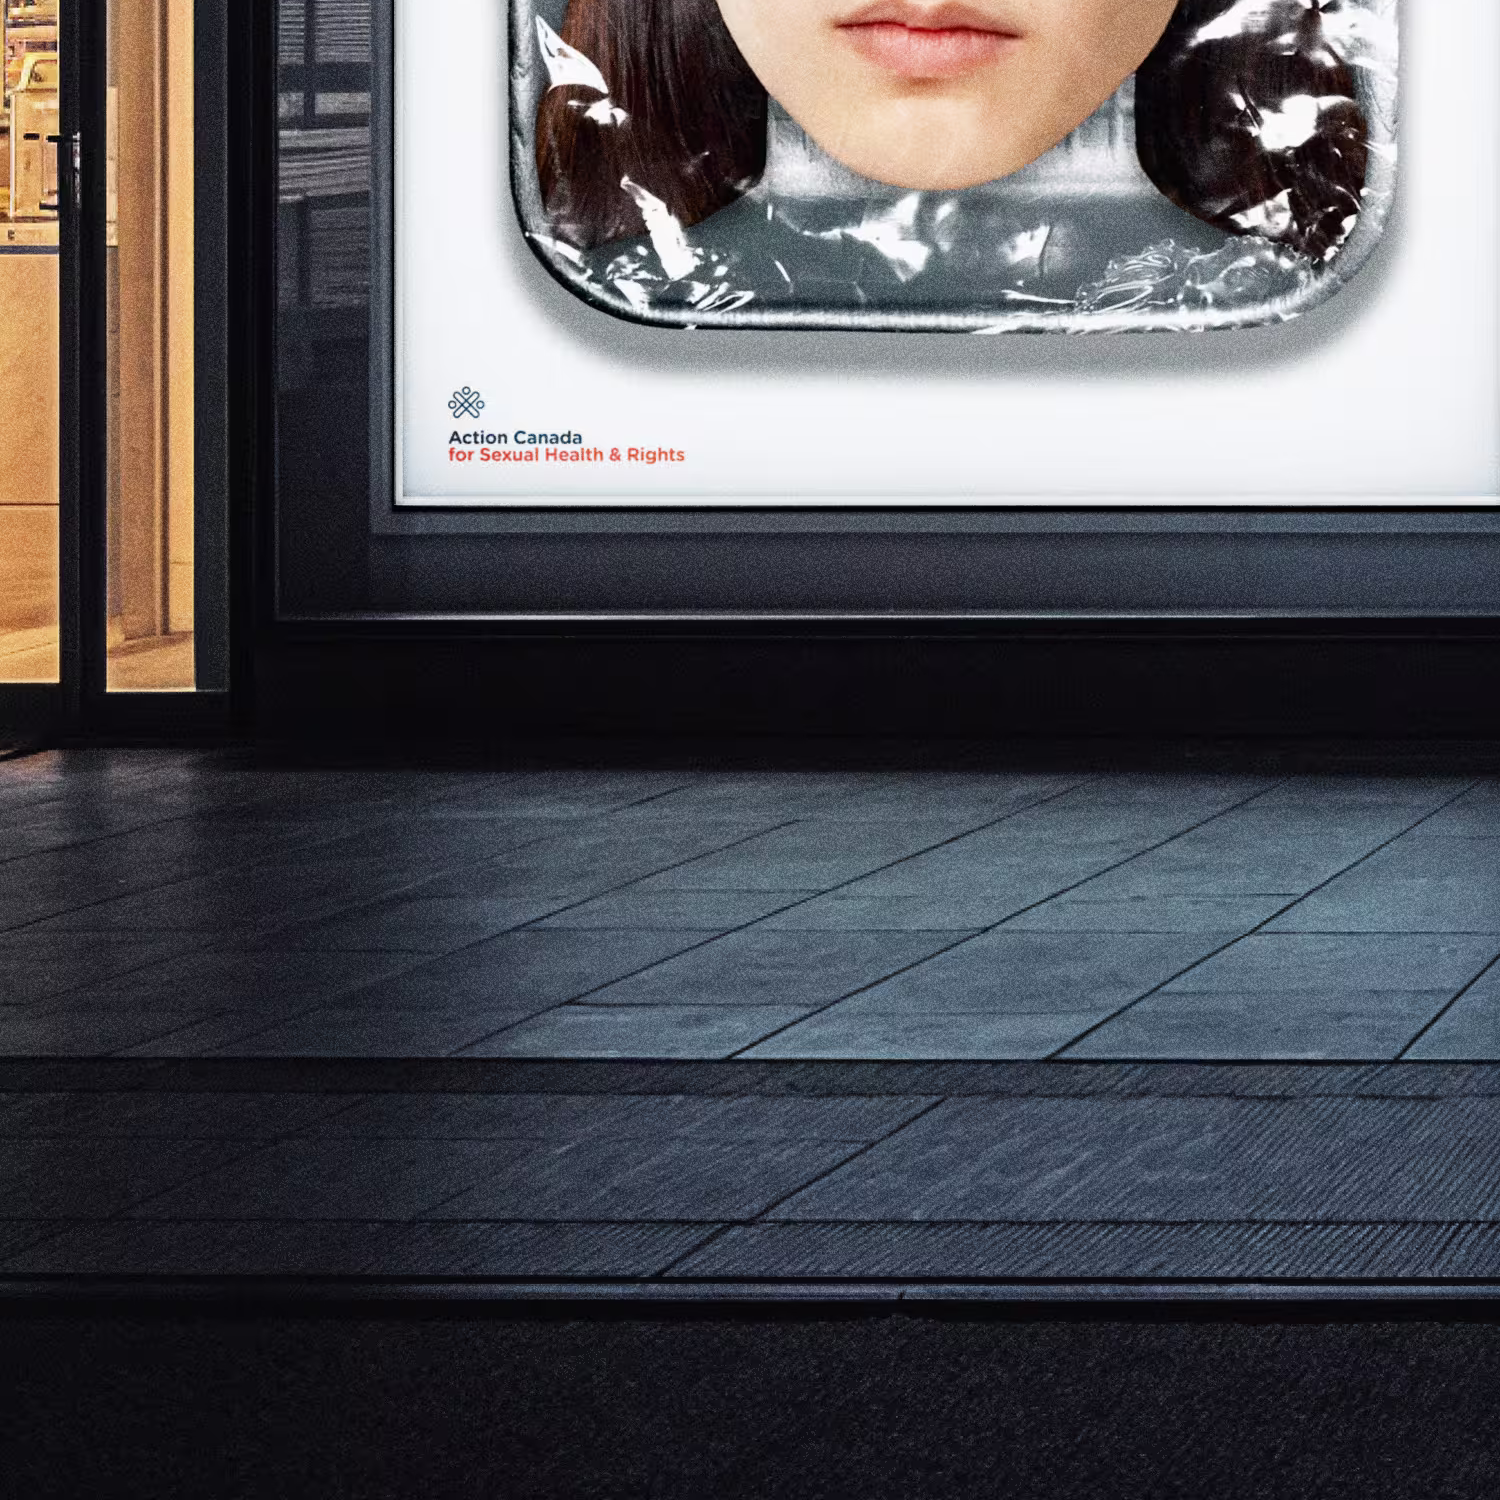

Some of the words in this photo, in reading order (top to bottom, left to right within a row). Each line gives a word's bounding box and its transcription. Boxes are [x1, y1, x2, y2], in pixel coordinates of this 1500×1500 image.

[449, 430, 508, 445] Action
[514, 430, 582, 445] Canada
[449, 447, 475, 462] for
[480, 447, 539, 462] Sexual
[545, 447, 604, 462] Health
[609, 447, 621, 462] &
[627, 447, 685, 464] Rights
